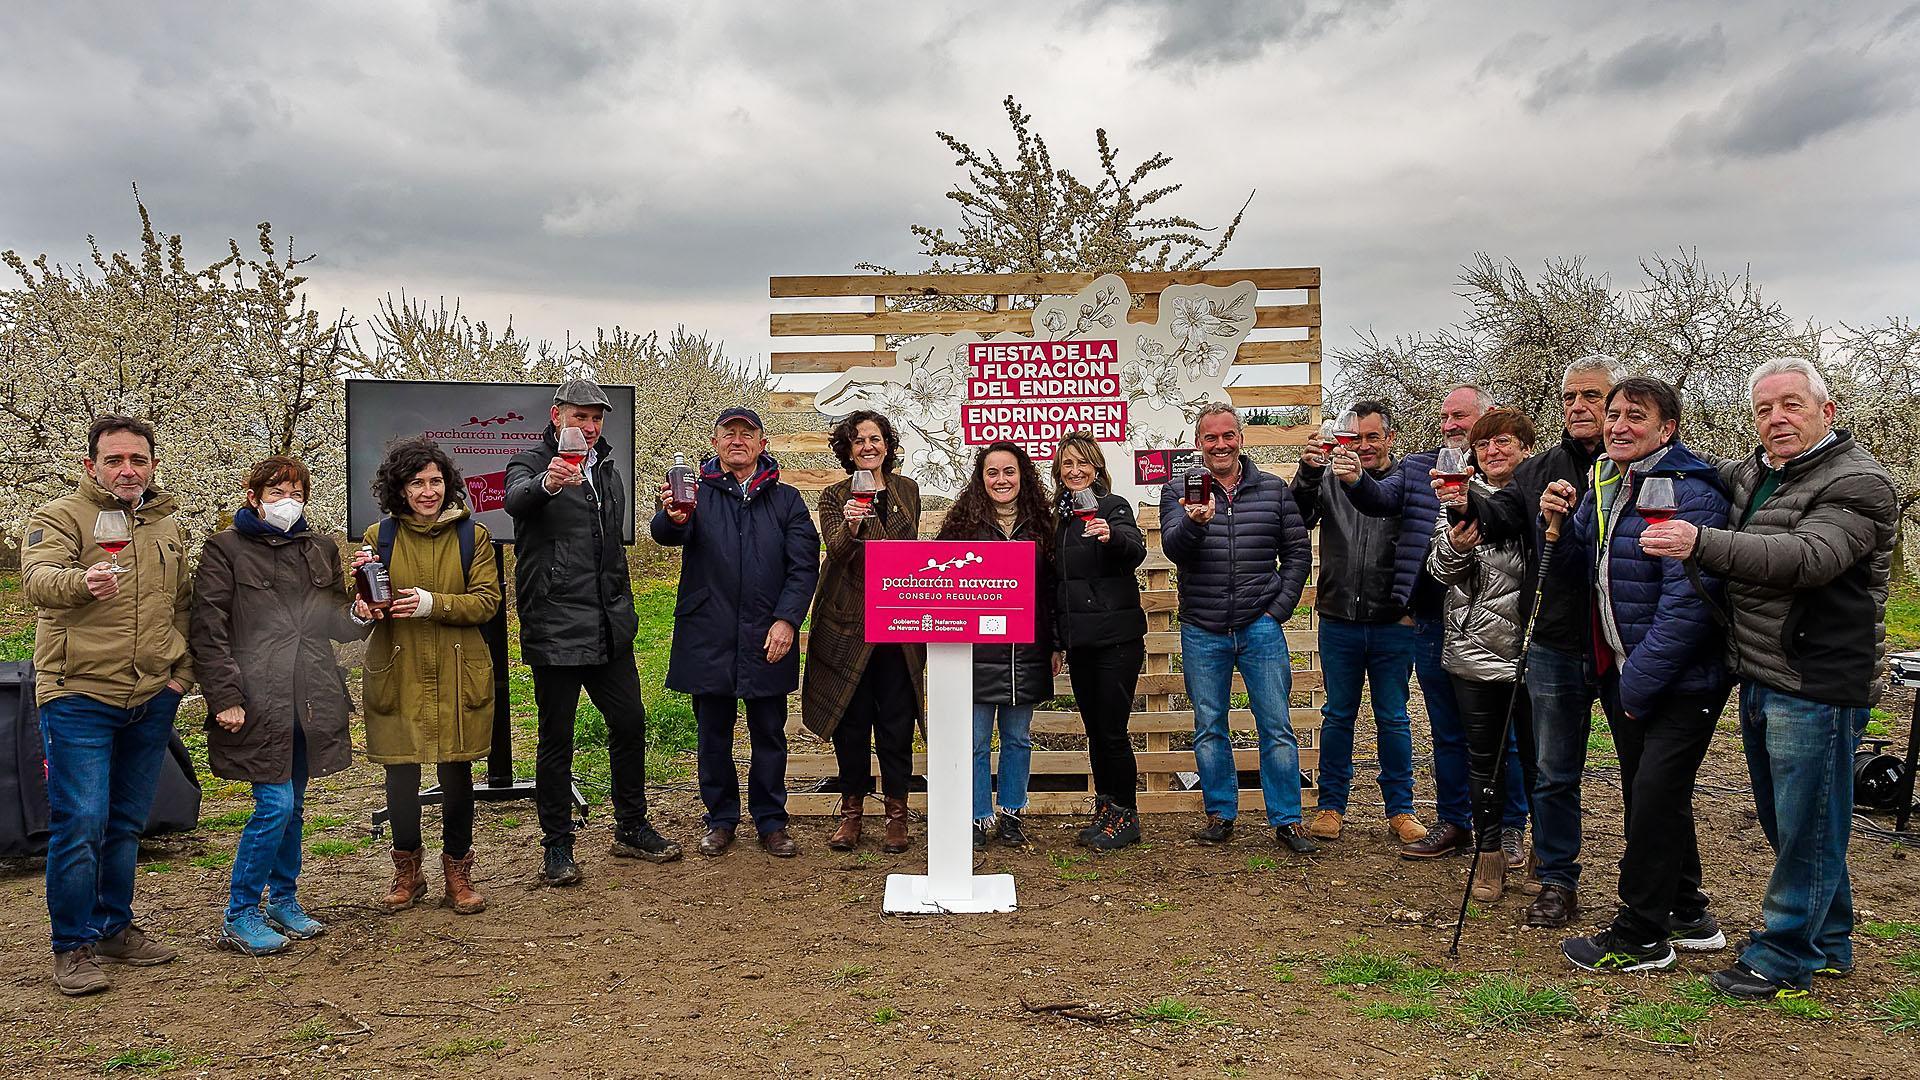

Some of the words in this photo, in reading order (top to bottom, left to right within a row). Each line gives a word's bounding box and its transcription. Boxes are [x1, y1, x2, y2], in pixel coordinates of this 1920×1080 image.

[974, 345, 1046, 362] FIESTA
[1052, 344, 1079, 361] DE
[1085, 343, 1113, 360] LA
[983, 357, 1105, 380] FLORACIÓN
[973, 381, 1014, 397] DEL
[1019, 379, 1116, 396] ENDRINO
[968, 405, 1122, 424] ENDRINOAREN
[425, 428, 496, 440] pacharán
[882, 574, 954, 590] pacharán
[958, 577, 1018, 589] navarro
[898, 592, 942, 600] CONSEJO
